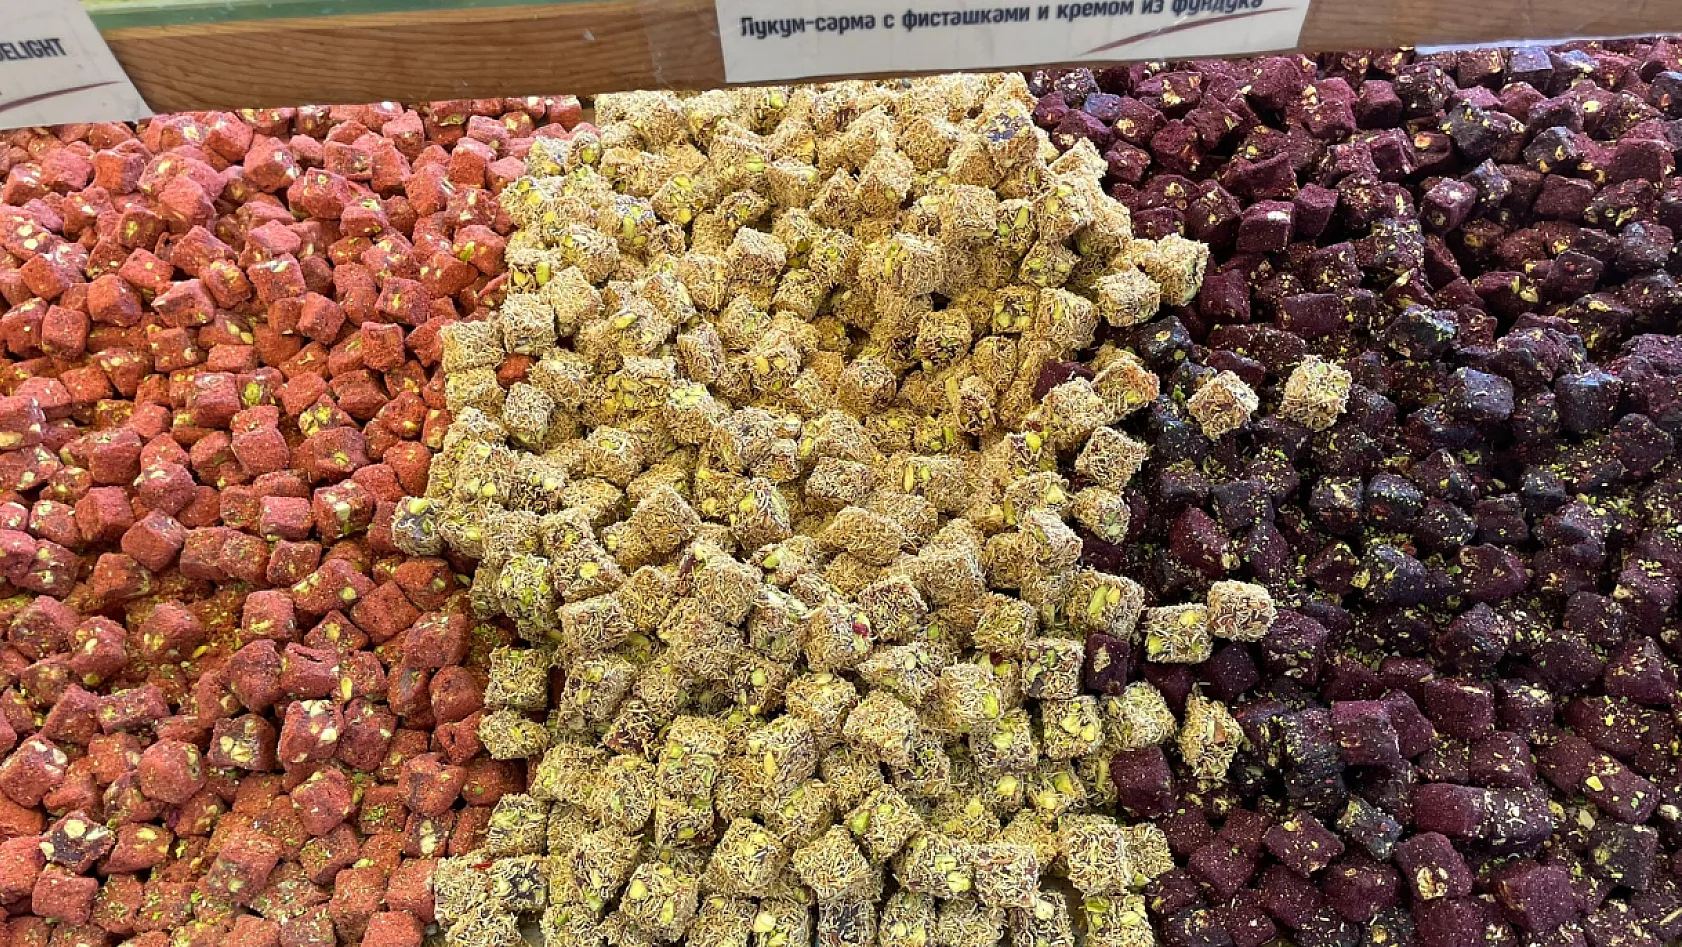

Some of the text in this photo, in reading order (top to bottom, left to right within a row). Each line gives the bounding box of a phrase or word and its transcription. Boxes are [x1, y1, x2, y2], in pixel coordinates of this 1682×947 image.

[741, 14, 876, 40] Лукум-сарма
[883, 13, 895, 29] с
[902, 6, 1030, 32] фисташками
[1037, 5, 1049, 20] и
[1057, 0, 1134, 22] кремом
[1141, 0, 1164, 14] из
